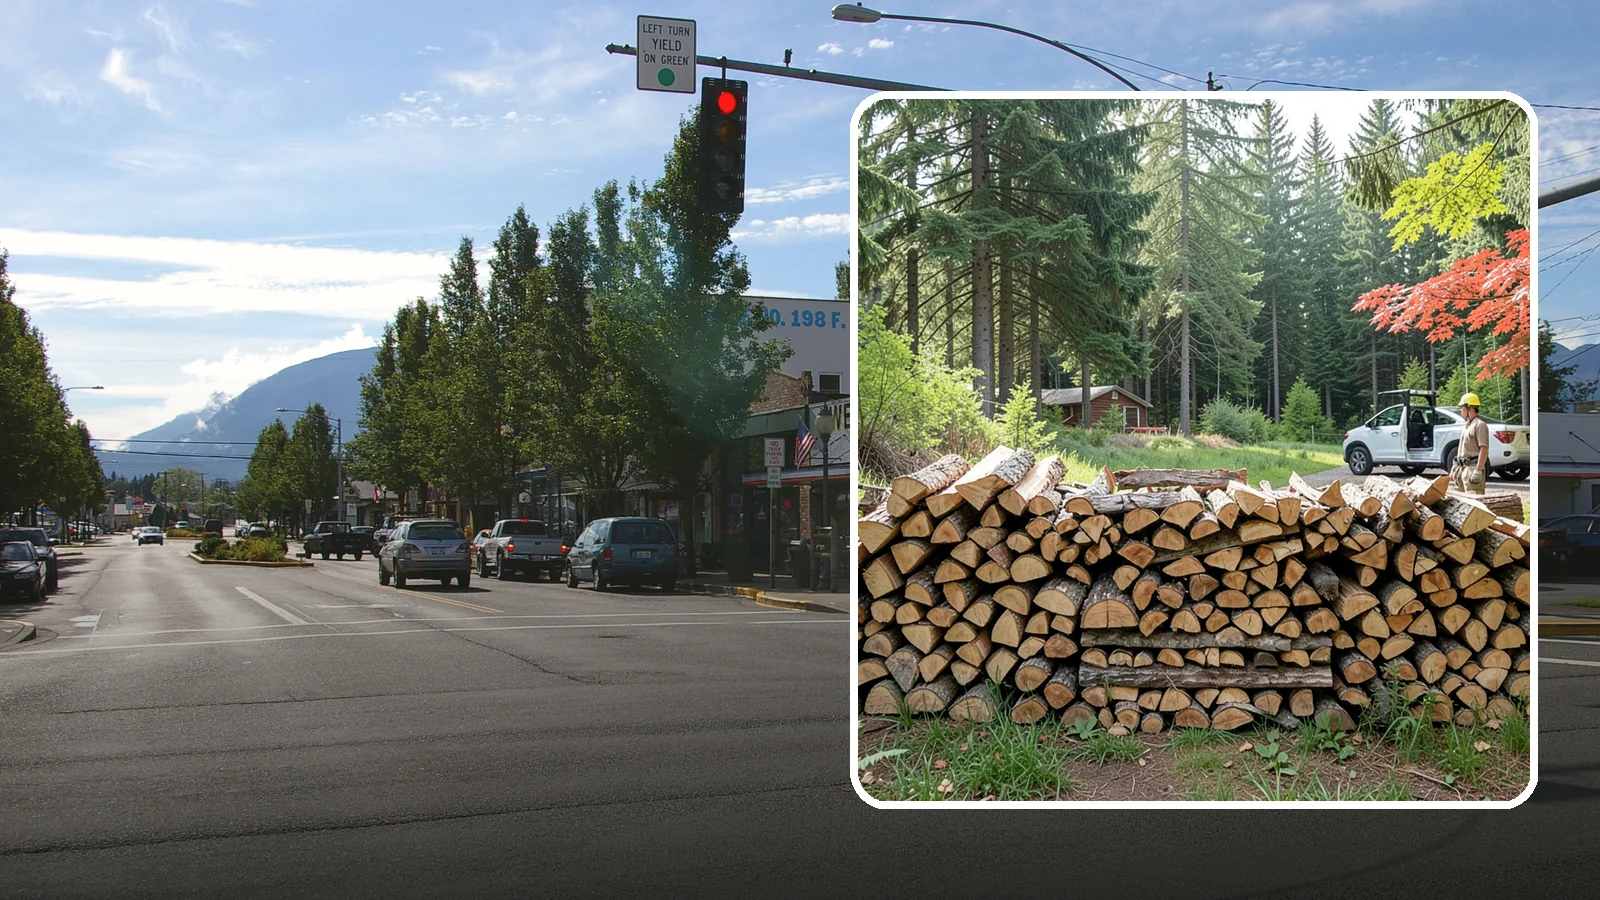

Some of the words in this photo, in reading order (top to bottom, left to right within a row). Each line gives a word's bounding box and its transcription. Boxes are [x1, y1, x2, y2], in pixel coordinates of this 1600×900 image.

[643, 24, 663, 34] LEFT
[668, 26, 690, 36] TURN
[652, 38, 682, 51] YIELD
[644, 53, 656, 64] ON
[661, 55, 688, 66] GREEN
[791, 309, 826, 328] 198
[831, 311, 846, 329] F.
